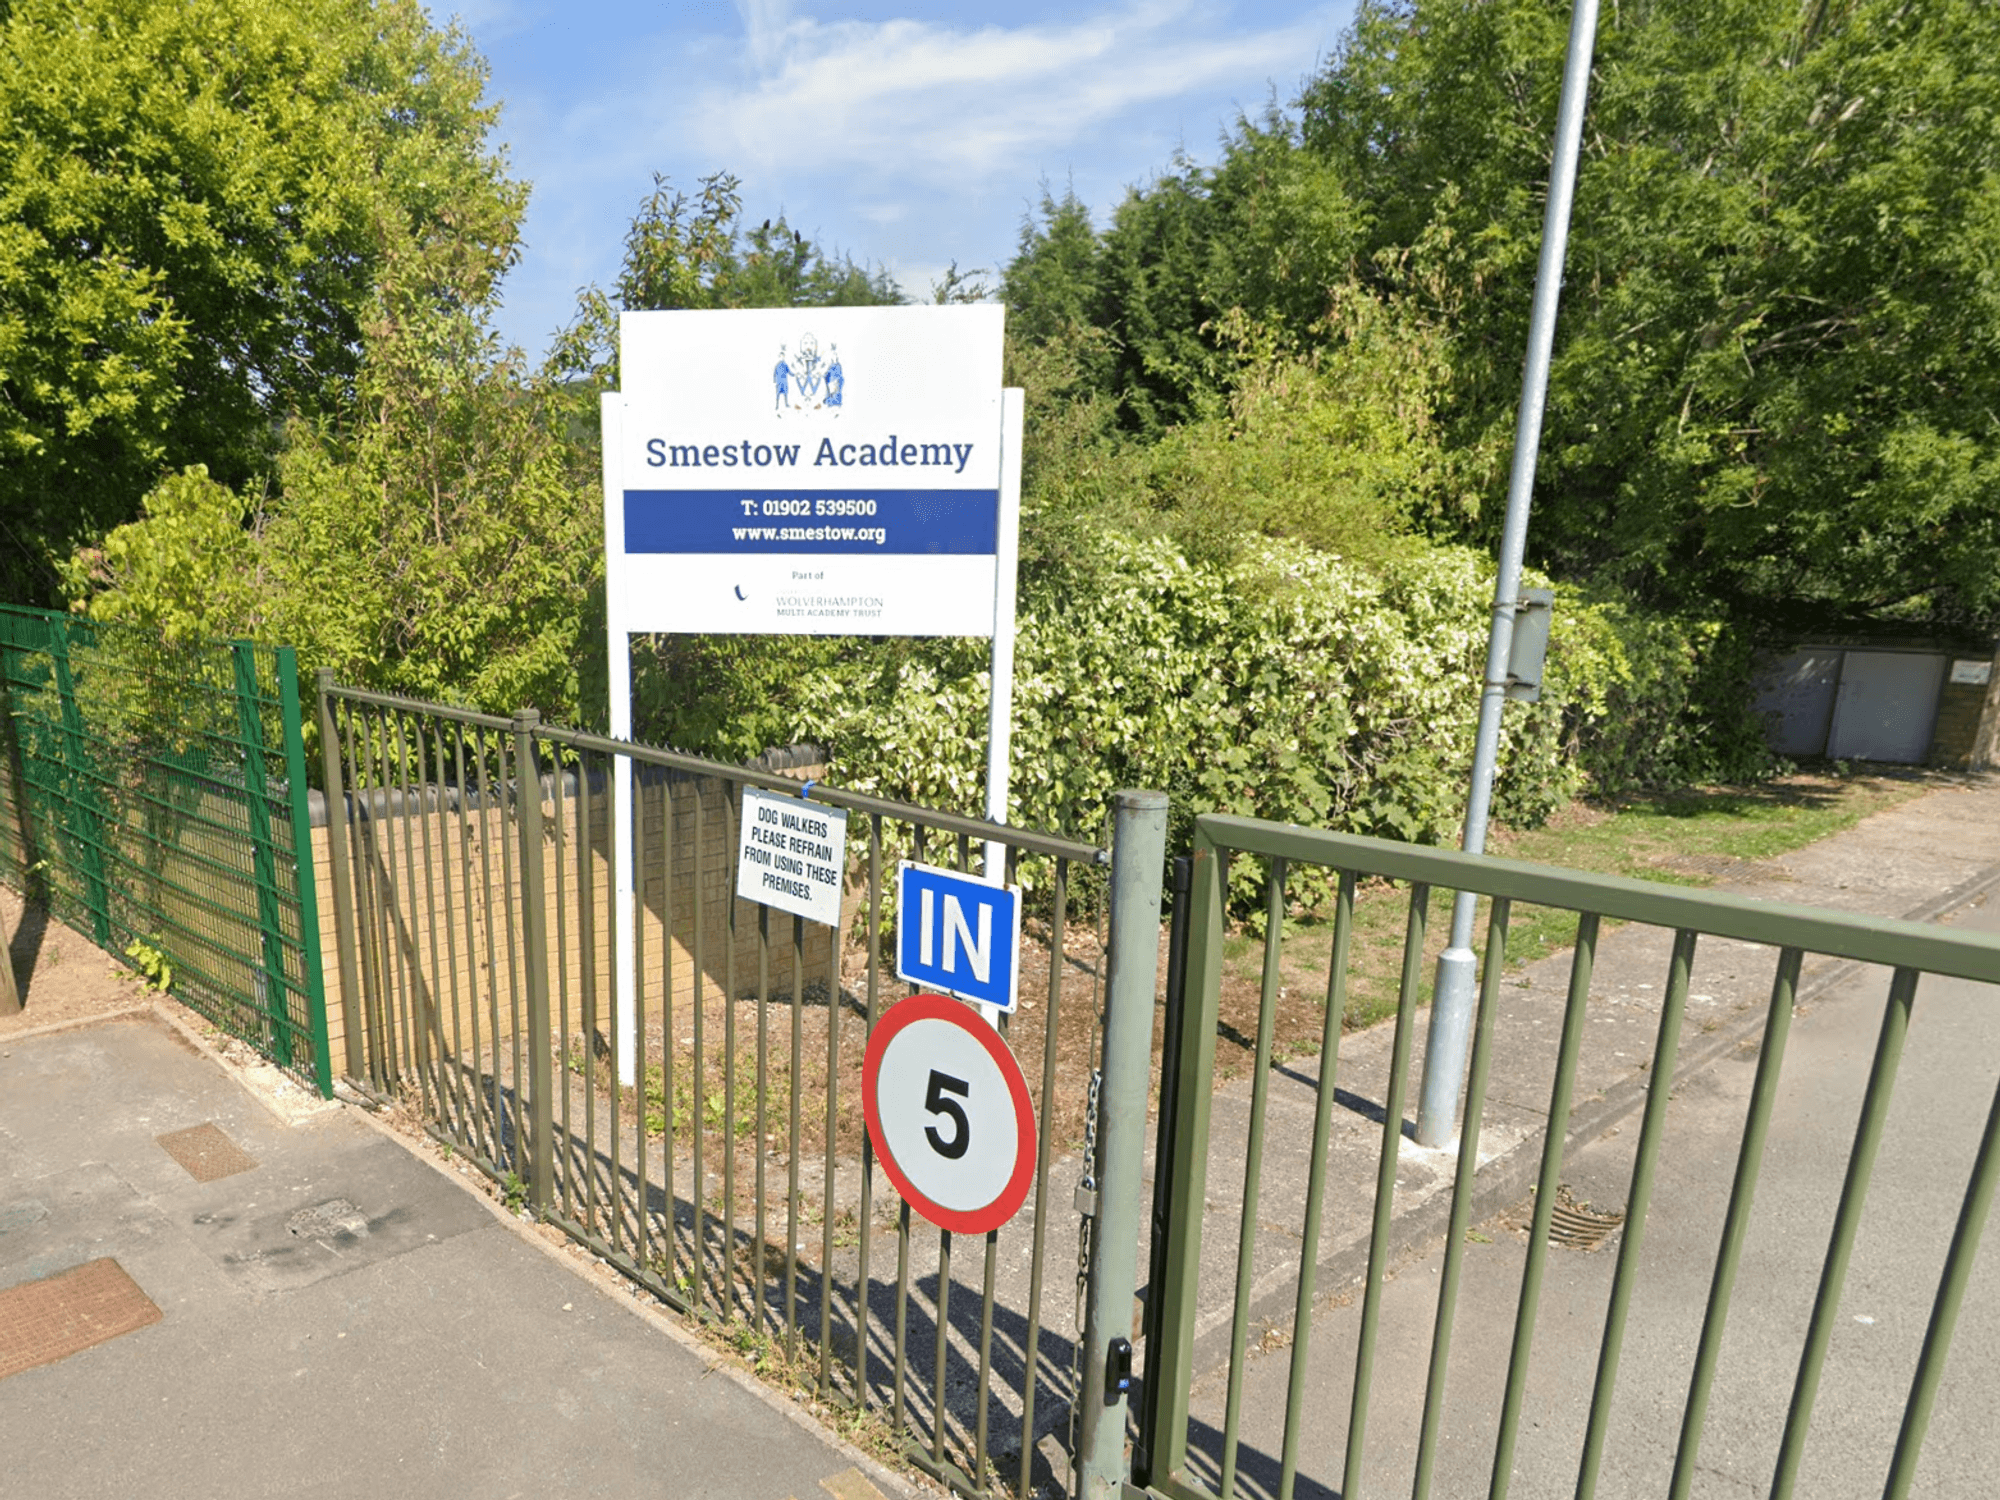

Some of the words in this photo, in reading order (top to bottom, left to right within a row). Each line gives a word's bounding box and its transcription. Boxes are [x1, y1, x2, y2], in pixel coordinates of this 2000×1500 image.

[646, 438, 800, 467] Smestow
[813, 435, 974, 473] Academy
[741, 499, 759, 516] T:
[762, 499, 811, 517] 01902
[815, 499, 877, 516] 539500
[732, 525, 886, 544] www.smestow.org
[792, 571, 812, 580] Part
[814, 571, 824, 580] of
[776, 596, 883, 607] WOLVERHAMPTON
[776, 608, 804, 617] MULTI
[807, 609, 849, 617] ACADEMY
[853, 609, 882, 617] TRUST
[758, 806, 778, 825] DOG
[781, 812, 827, 838] WALKERS
[751, 826, 787, 849] PLEASE
[789, 836, 833, 862] REFRAIN
[744, 845, 771, 867] FROM
[774, 854, 803, 875] USING
[806, 862, 837, 886] THESE
[762, 872, 812, 901] PREMISES.
[919, 888, 993, 984] IN
[924, 1069, 970, 1160] 5
